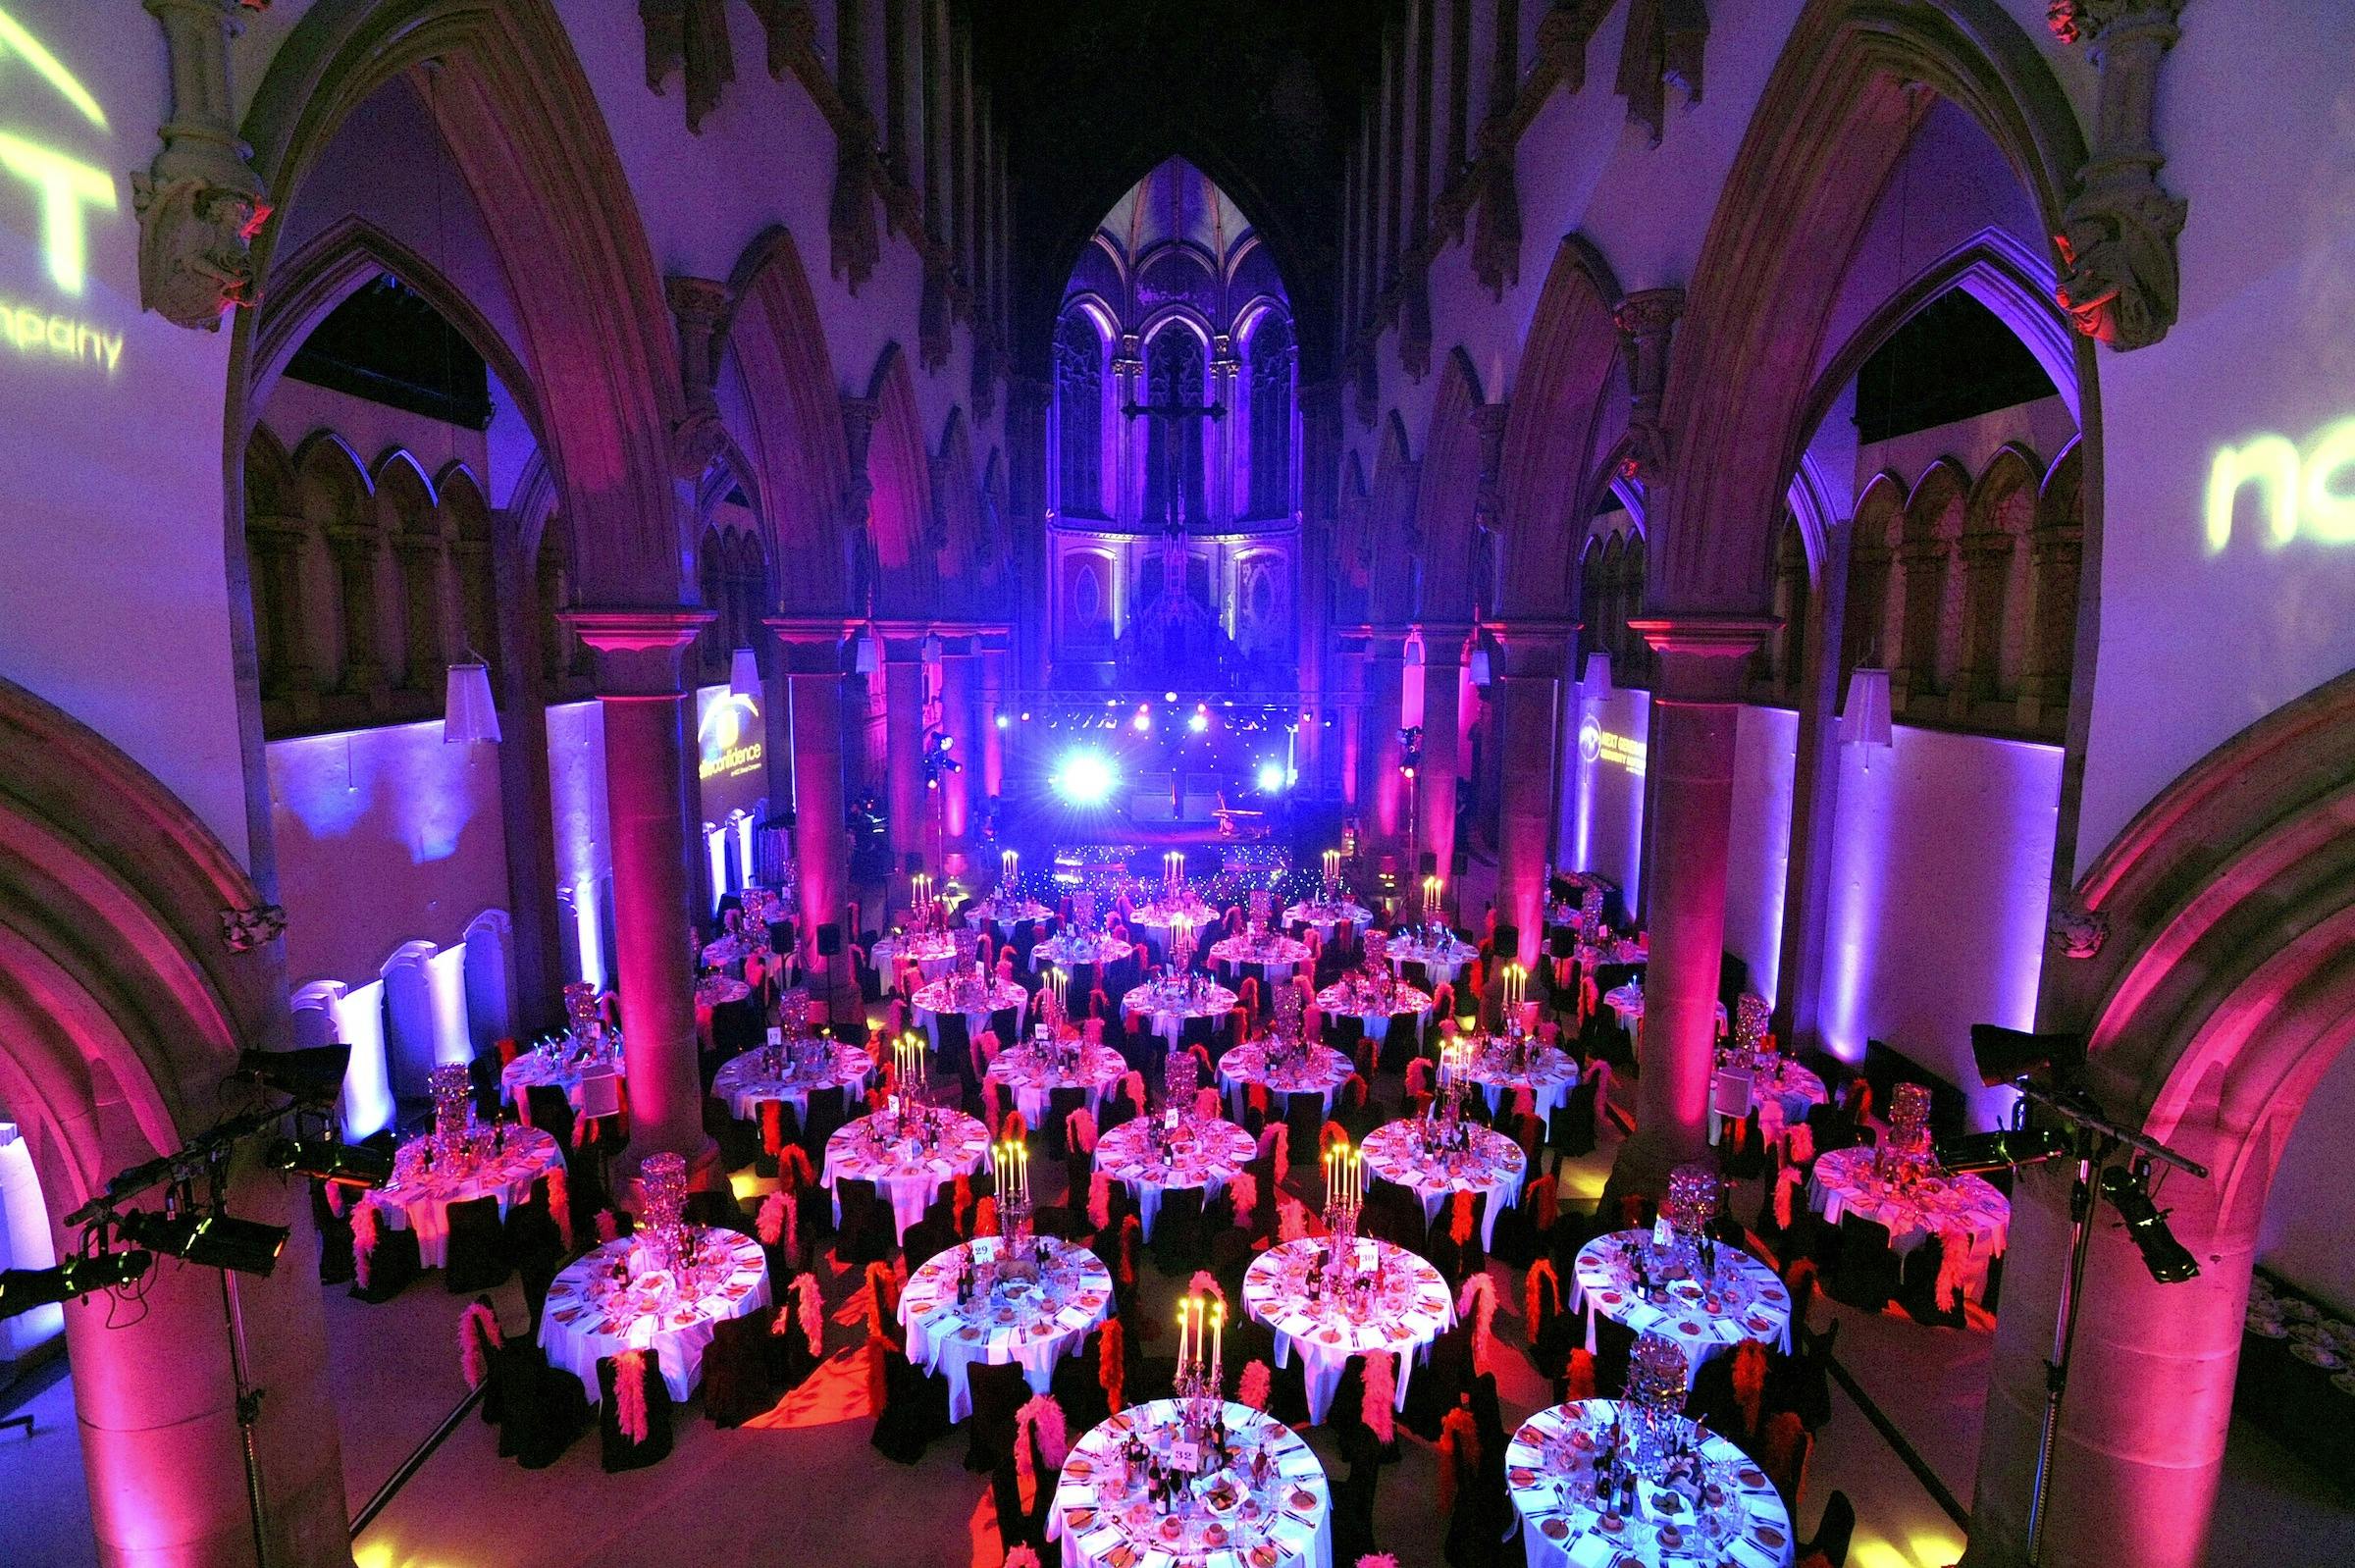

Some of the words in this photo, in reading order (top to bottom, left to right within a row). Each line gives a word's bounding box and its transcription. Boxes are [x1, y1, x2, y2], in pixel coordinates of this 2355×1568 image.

[975, 1245, 988, 1255] 29
[1361, 1254, 1375, 1263] 30
[1176, 1450, 1192, 1461] 32
